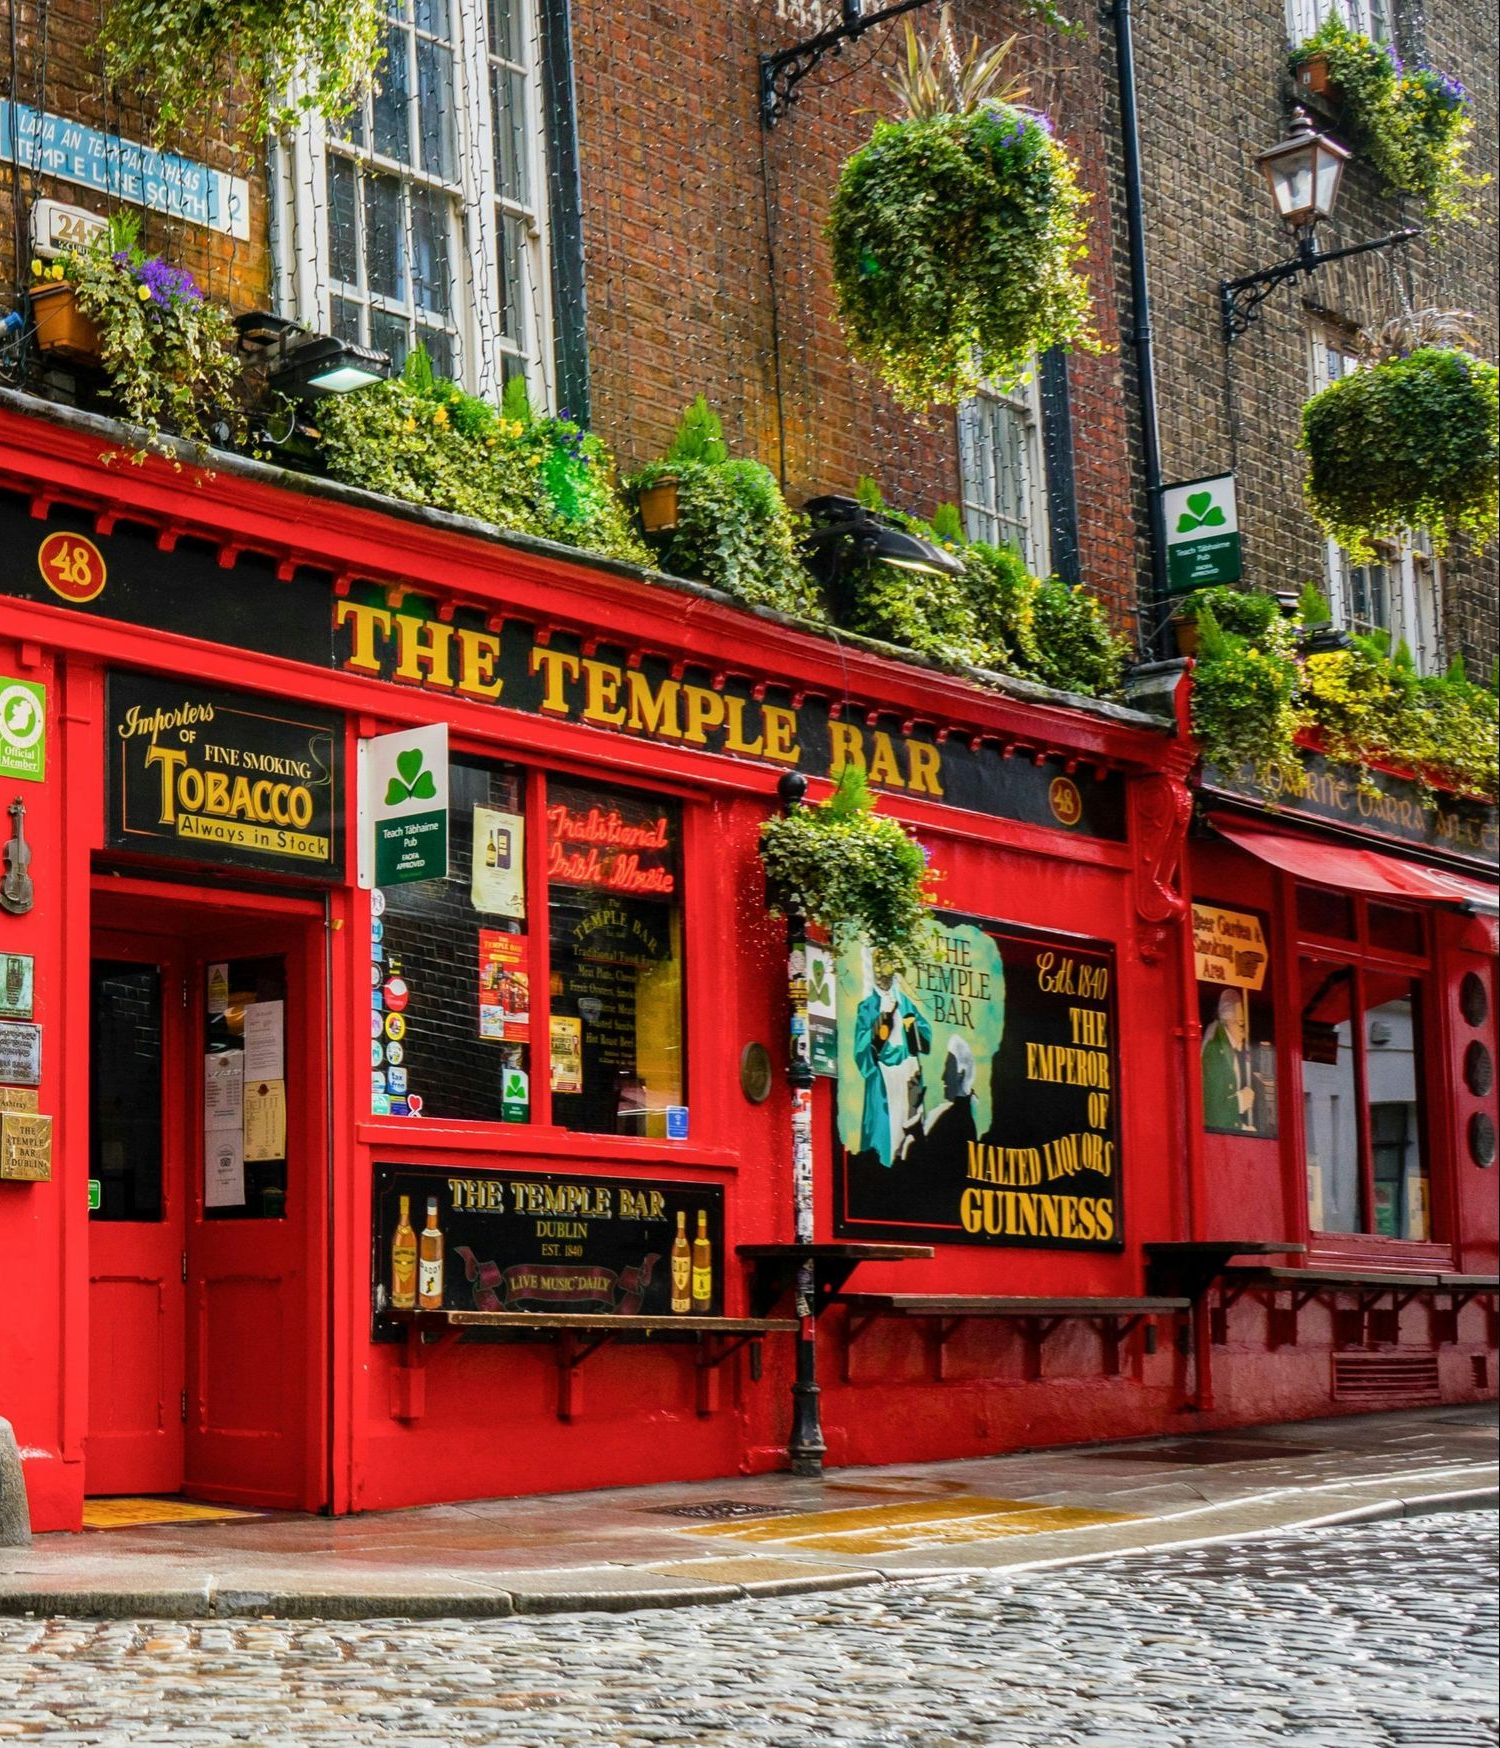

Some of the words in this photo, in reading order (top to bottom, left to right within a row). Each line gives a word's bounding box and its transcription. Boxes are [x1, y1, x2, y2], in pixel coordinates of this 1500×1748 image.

[61, 129, 82, 150] AN
[93, 162, 139, 195] LANE
[147, 182, 206, 218] SOUTH
[50, 542, 93, 587] 48
[118, 701, 215, 744] Importers
[337, 600, 503, 701] THE
[532, 646, 802, 765] TEMPLE
[828, 720, 943, 797] BAR
[1053, 786, 1076, 815] 48
[4, 746, 35, 760] Official
[179, 728, 197, 744] OF
[2, 756, 37, 770] Member
[204, 744, 240, 767] FINE
[242, 752, 312, 779] SMOKING
[145, 745, 313, 829] TOBACCO
[181, 816, 245, 842] Always
[254, 829, 269, 846] in
[277, 831, 325, 856] Stock
[383, 827, 404, 839] Teach
[404, 837, 418, 847] Pub
[547, 805, 668, 848] Traditional
[396, 860, 426, 870] APPROVED
[548, 842, 603, 882] Irish
[610, 854, 674, 892] Music
[573, 910, 627, 940] TEMPLE
[633, 920, 658, 953] BAR
[1218, 914, 1253, 941] Garden
[935, 935, 972, 968] THE
[916, 961, 991, 1001] TEMPLE
[1078, 962, 1108, 1000] 1840
[1203, 958, 1226, 981] Area
[932, 994, 975, 1030] BAR
[1069, 1007, 1107, 1048] THE
[391, 1072, 403, 1081] tax
[1025, 1042, 1110, 1090] EMPEROR
[1, 1100, 26, 1109] Ashtray
[1087, 1092, 1109, 1130] OF
[11, 1137, 45, 1147] TEMPLE
[19, 1127, 36, 1136] THE
[11, 1158, 44, 1168] DUBLIN
[19, 1148, 36, 1157] BAR
[966, 1140, 1041, 1186] MALTED
[1043, 1132, 1114, 1181] LIQUORS
[448, 1178, 504, 1214] THE
[510, 1182, 612, 1219] TEMPLE
[619, 1189, 668, 1222] BAR
[960, 1188, 1114, 1241] GUINNESS
[536, 1220, 588, 1238] DUBLIN
[541, 1243, 561, 1256] EST.
[565, 1244, 583, 1257] 1840
[510, 1274, 538, 1291] LIVE
[540, 1276, 575, 1291] MUSIC
[578, 1276, 611, 1291] DAILY
